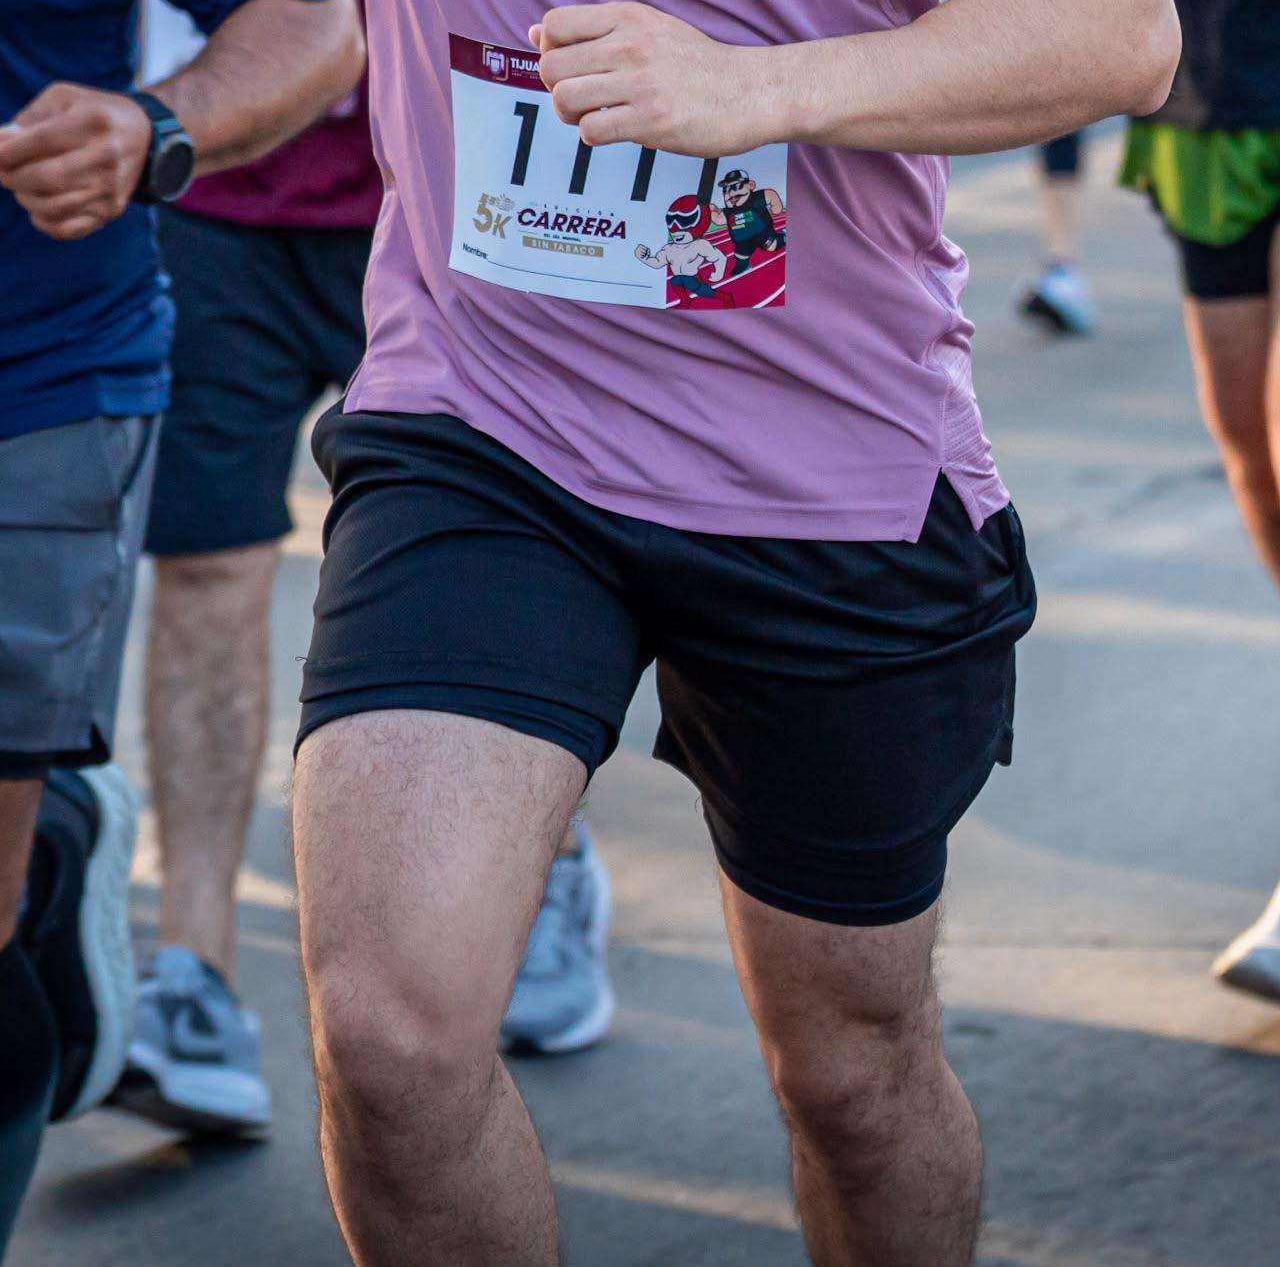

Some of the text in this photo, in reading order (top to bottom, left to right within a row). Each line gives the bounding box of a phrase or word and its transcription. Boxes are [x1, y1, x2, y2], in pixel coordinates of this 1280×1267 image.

[510, 57, 540, 72] TIJUA
[517, 208, 627, 240] CARRERA
[553, 242, 597, 256] TABACO
